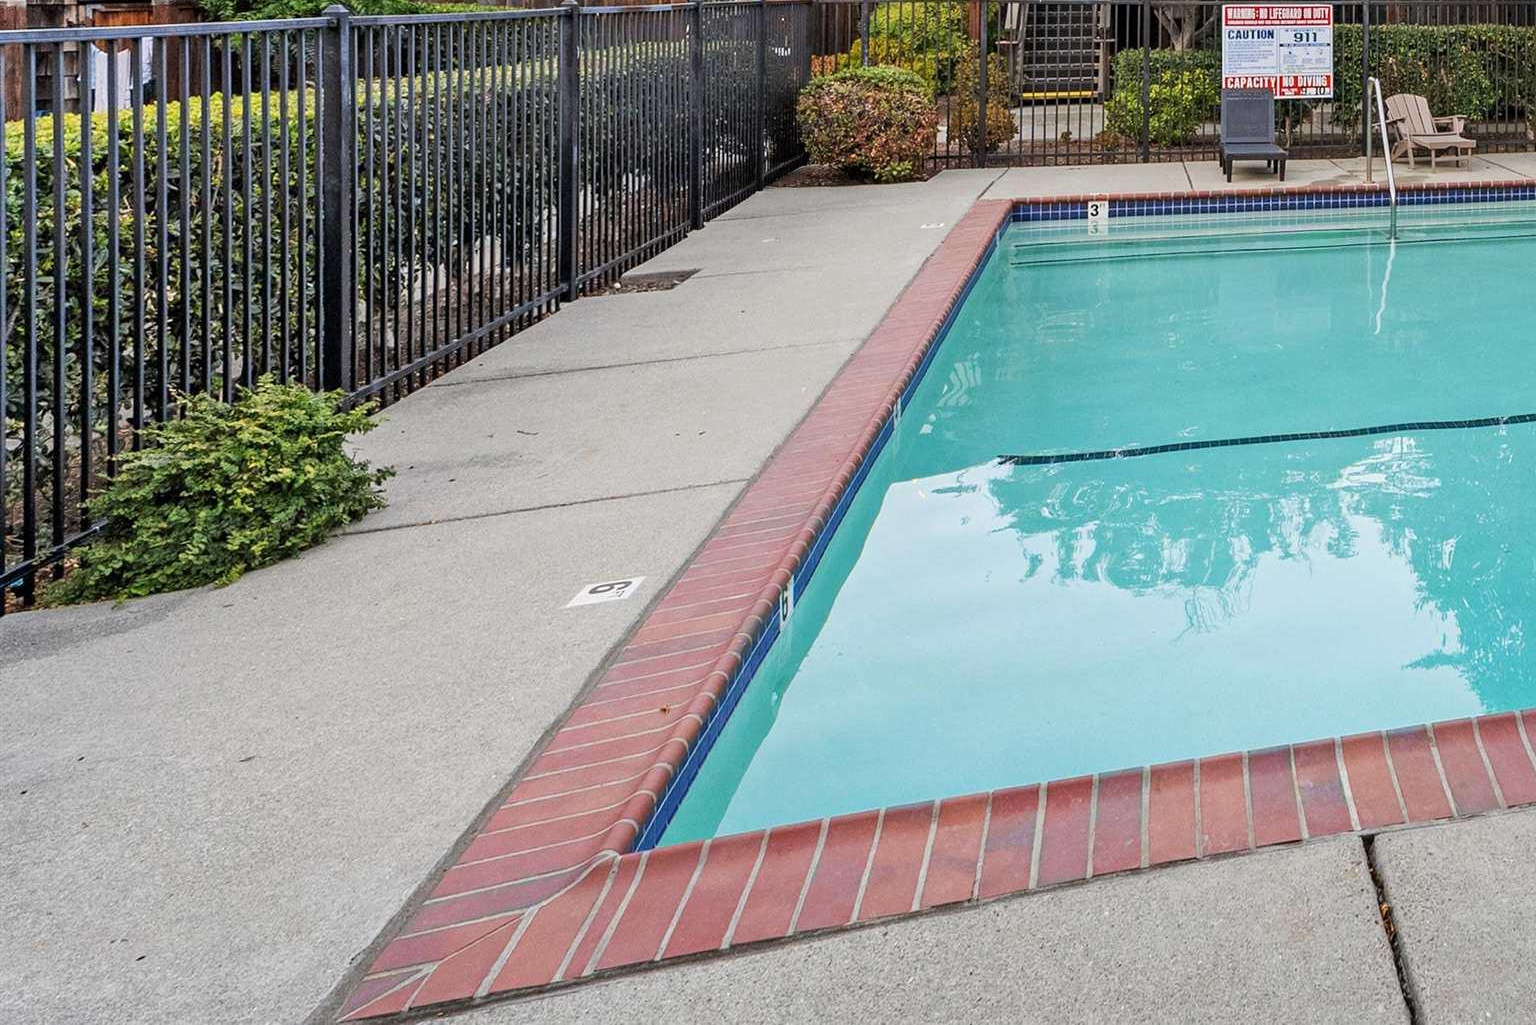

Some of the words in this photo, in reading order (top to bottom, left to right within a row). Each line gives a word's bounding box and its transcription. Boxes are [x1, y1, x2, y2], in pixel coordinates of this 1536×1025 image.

[1269, 7, 1302, 19] LIFEGUARD
[1312, 7, 1329, 19] DUTY
[1228, 29, 1274, 40] CAUTION
[1294, 32, 1317, 42] 911
[1227, 77, 1276, 89] CAPACITY
[1282, 76, 1295, 87] NO
[1297, 75, 1328, 87] DIVING
[1090, 204, 1099, 216] 3
[589, 580, 633, 594] 6
